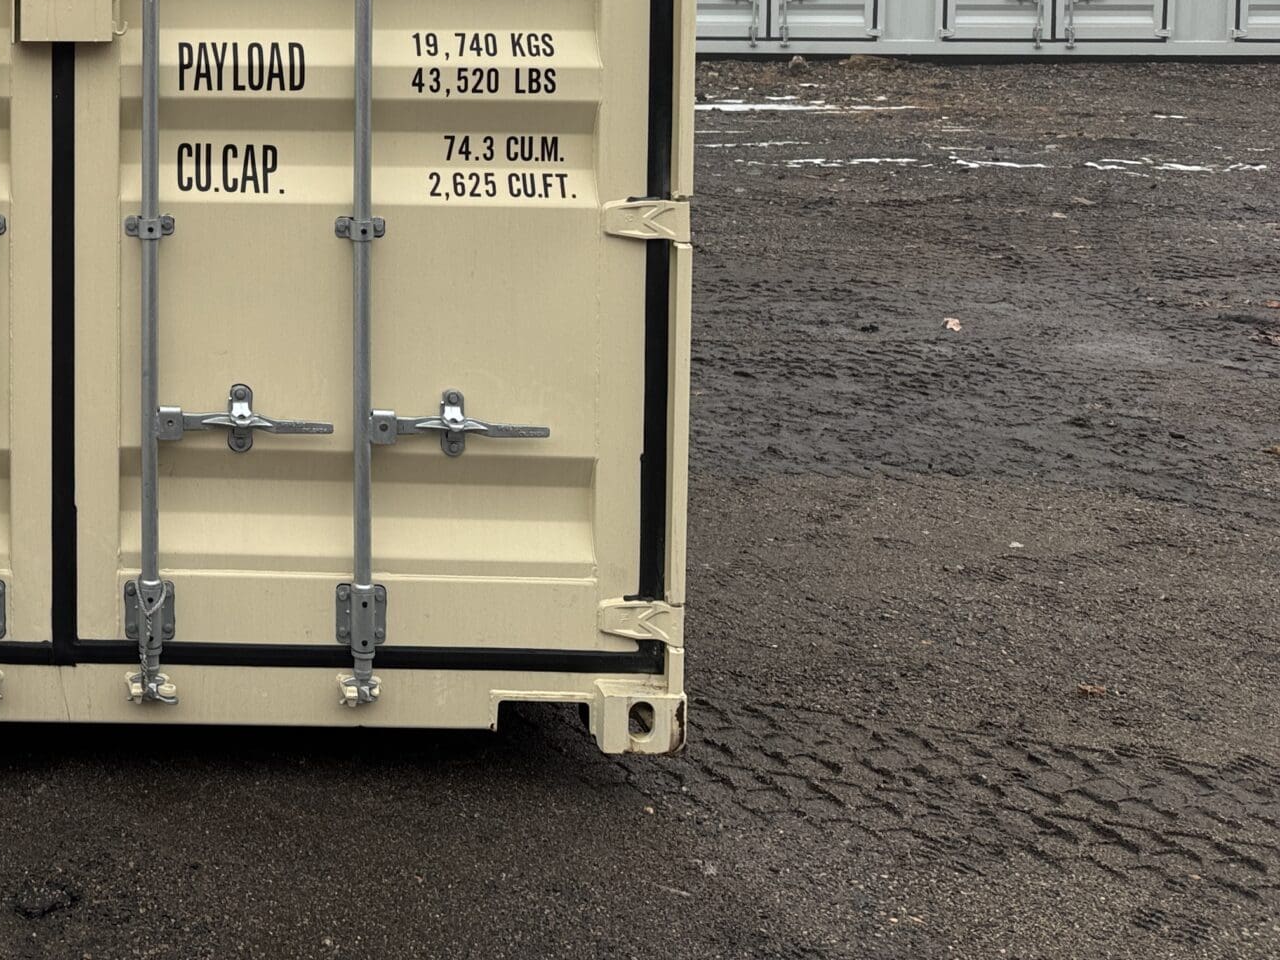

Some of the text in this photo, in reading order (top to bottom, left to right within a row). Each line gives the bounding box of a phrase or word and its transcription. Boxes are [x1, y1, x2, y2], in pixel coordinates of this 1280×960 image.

[412, 33, 555, 61] 19,740 KGS
[178, 42, 306, 92] PAYLOAD
[411, 67, 557, 98] 43,520 LBS
[443, 135, 565, 162] 74.3 CU.M.
[177, 142, 286, 194] CU.CAP.
[428, 172, 577, 200] 2,625 CU.FT.
